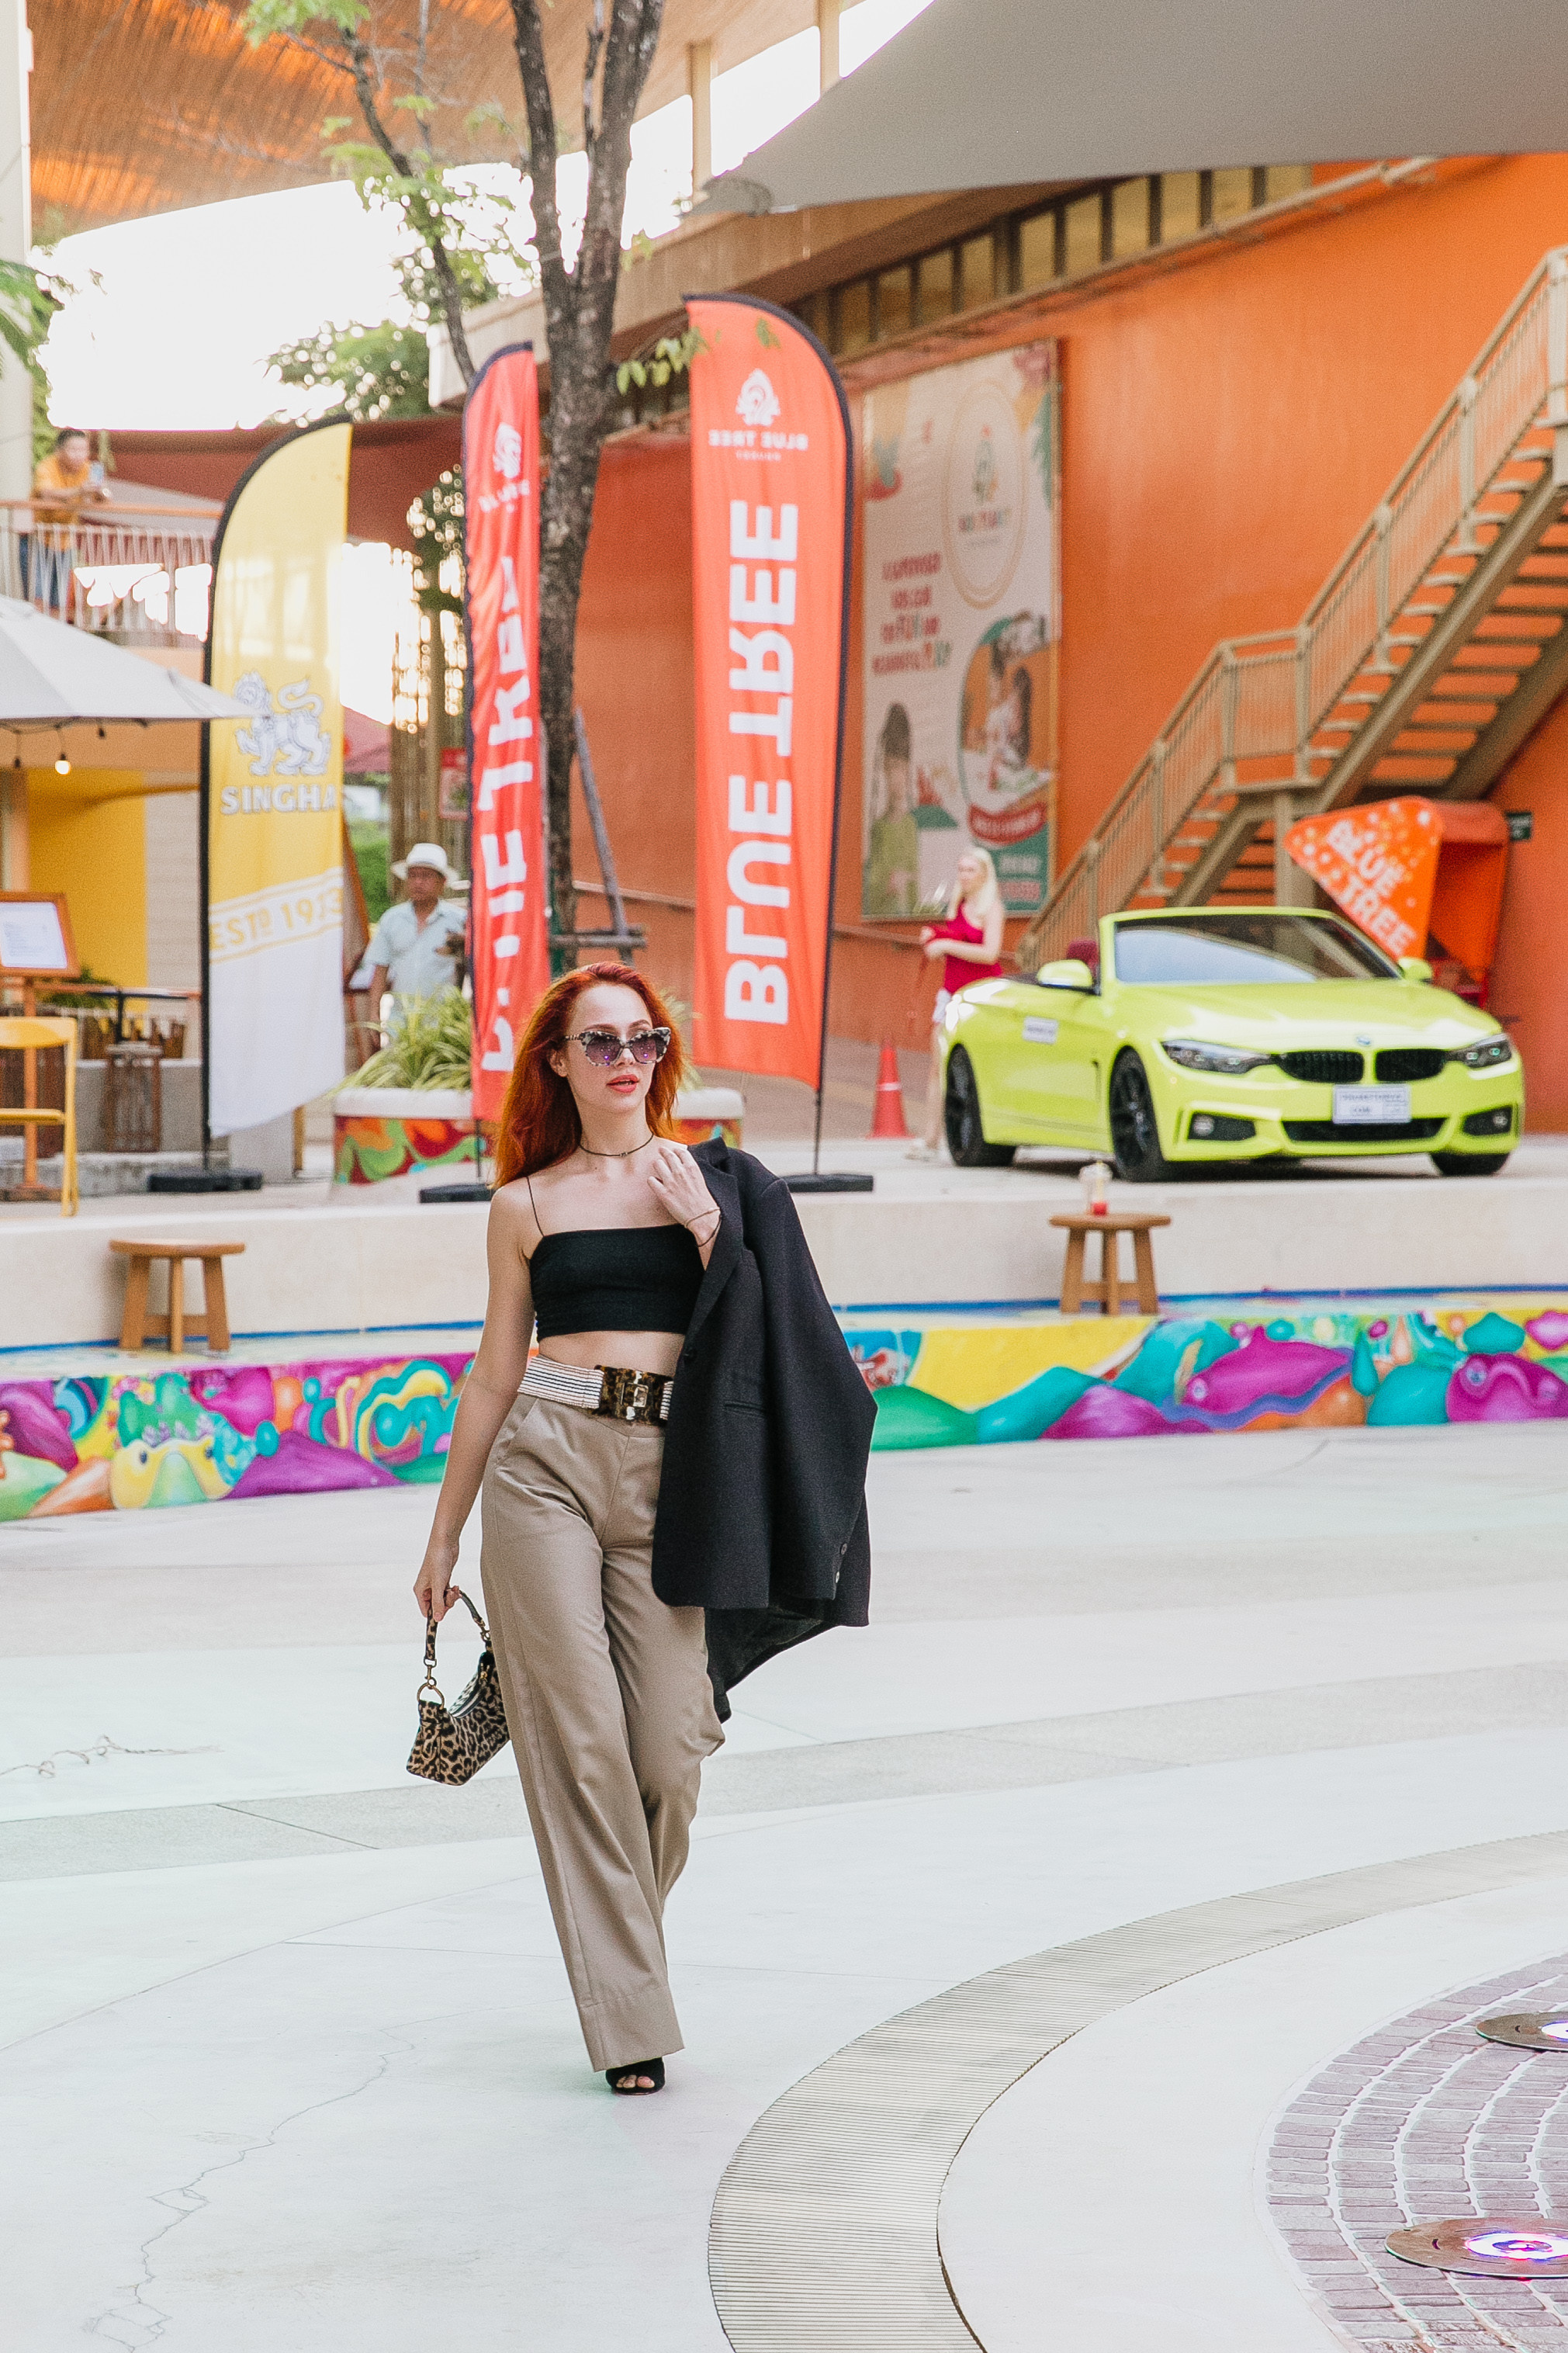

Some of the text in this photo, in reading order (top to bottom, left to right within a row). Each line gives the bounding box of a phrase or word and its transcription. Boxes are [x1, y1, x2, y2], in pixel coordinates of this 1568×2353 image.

[220, 783, 337, 816] SINGHA
[1326, 819, 1405, 897] BLUE
[1339, 874, 1417, 955] TREE
